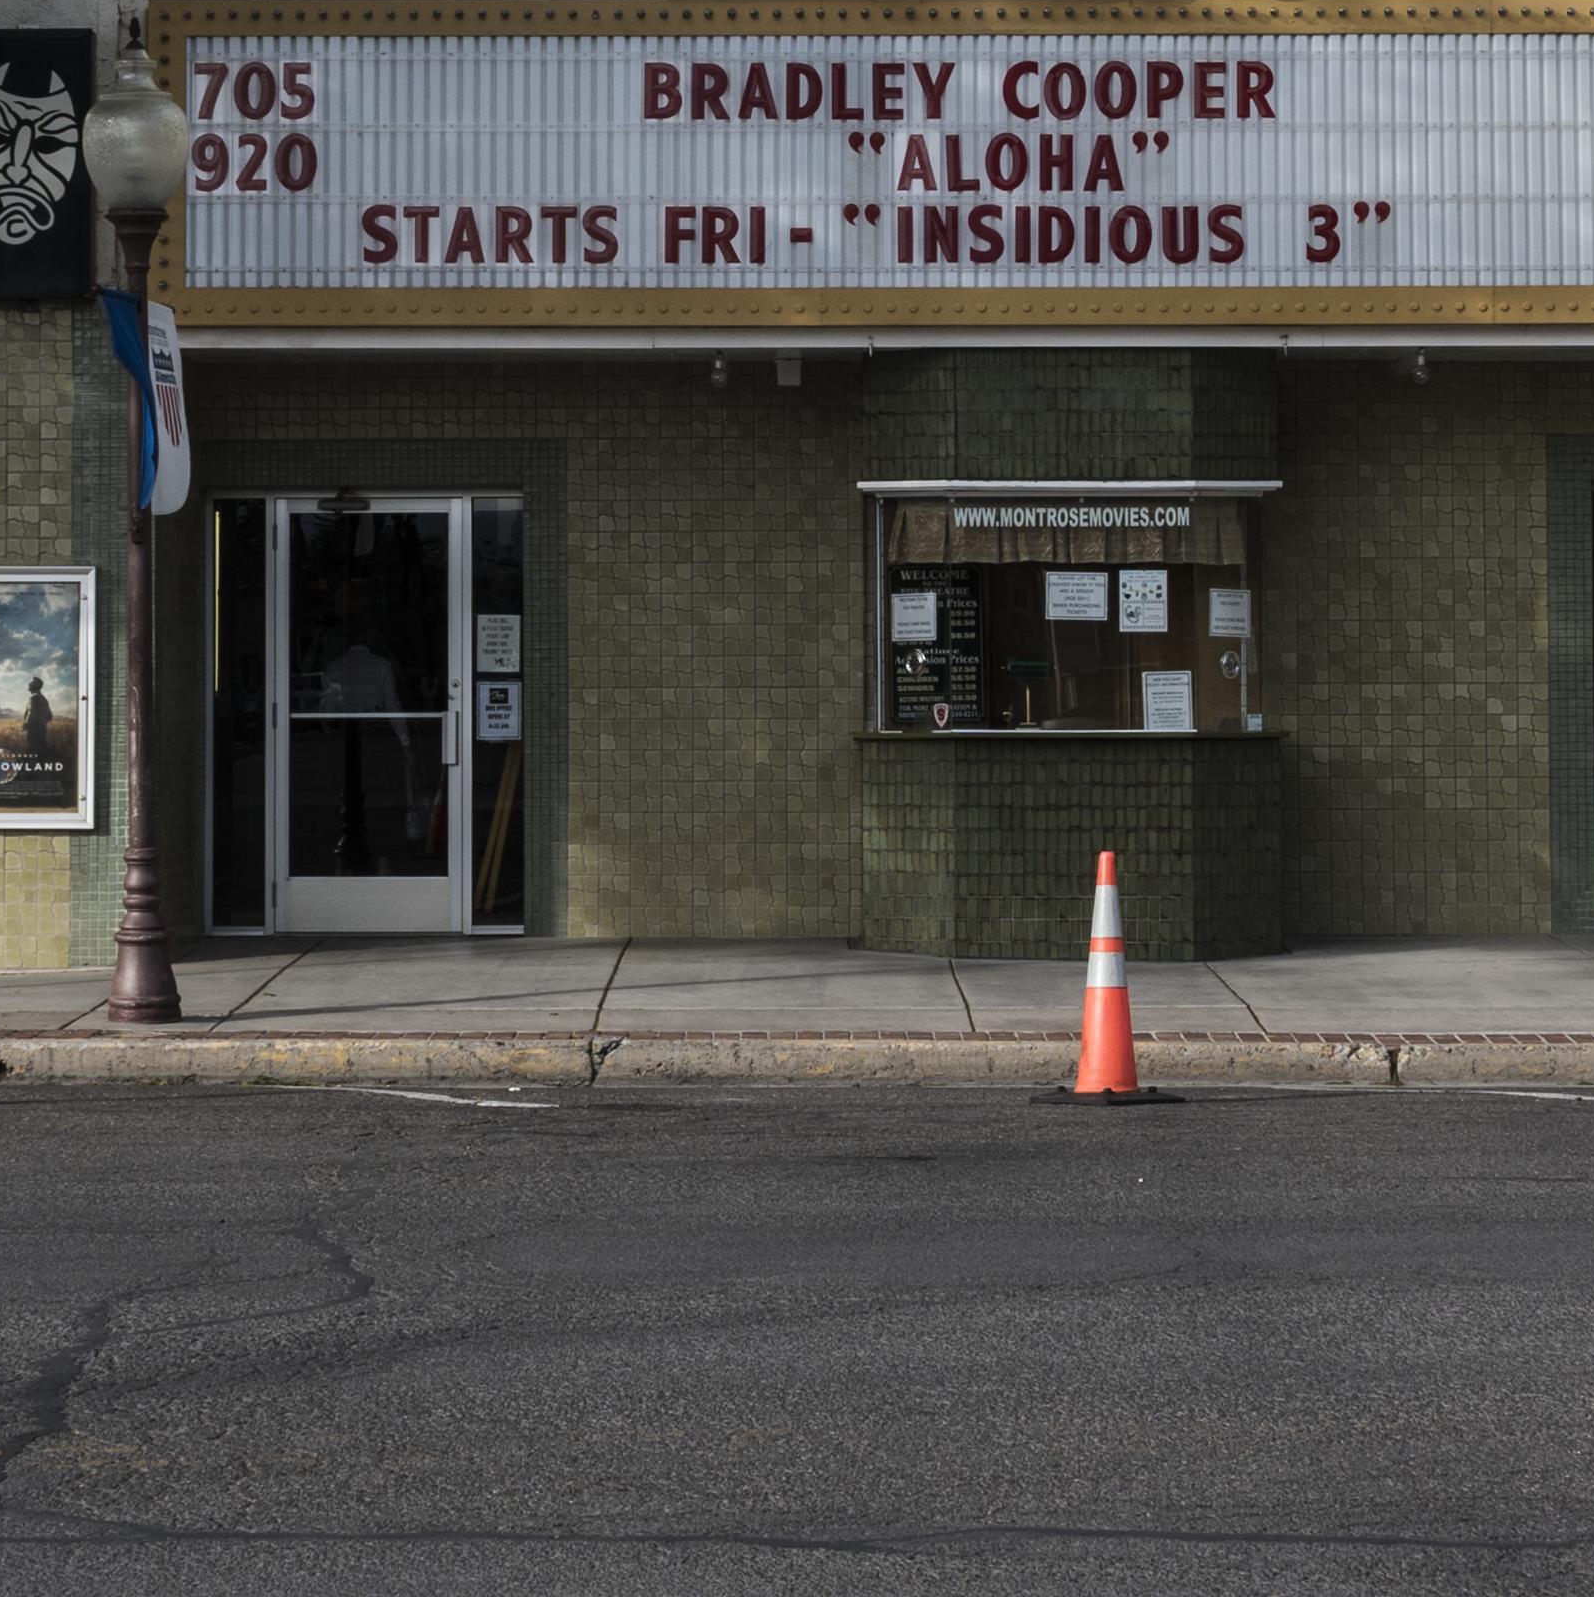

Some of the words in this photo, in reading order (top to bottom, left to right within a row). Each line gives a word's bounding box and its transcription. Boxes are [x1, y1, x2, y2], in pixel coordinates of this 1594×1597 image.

[192, 61, 315, 121] 705
[643, 61, 956, 121] BRADLEY
[1001, 60, 1276, 120] COOPER
[191, 133, 318, 193] 920
[848, 131, 1170, 193] "ALOHA"
[361, 205, 619, 266] STARTS
[953, 507, 1191, 528] WWW.MONTROSEMOVIES.COM
[900, 569, 969, 580] WELCOME
